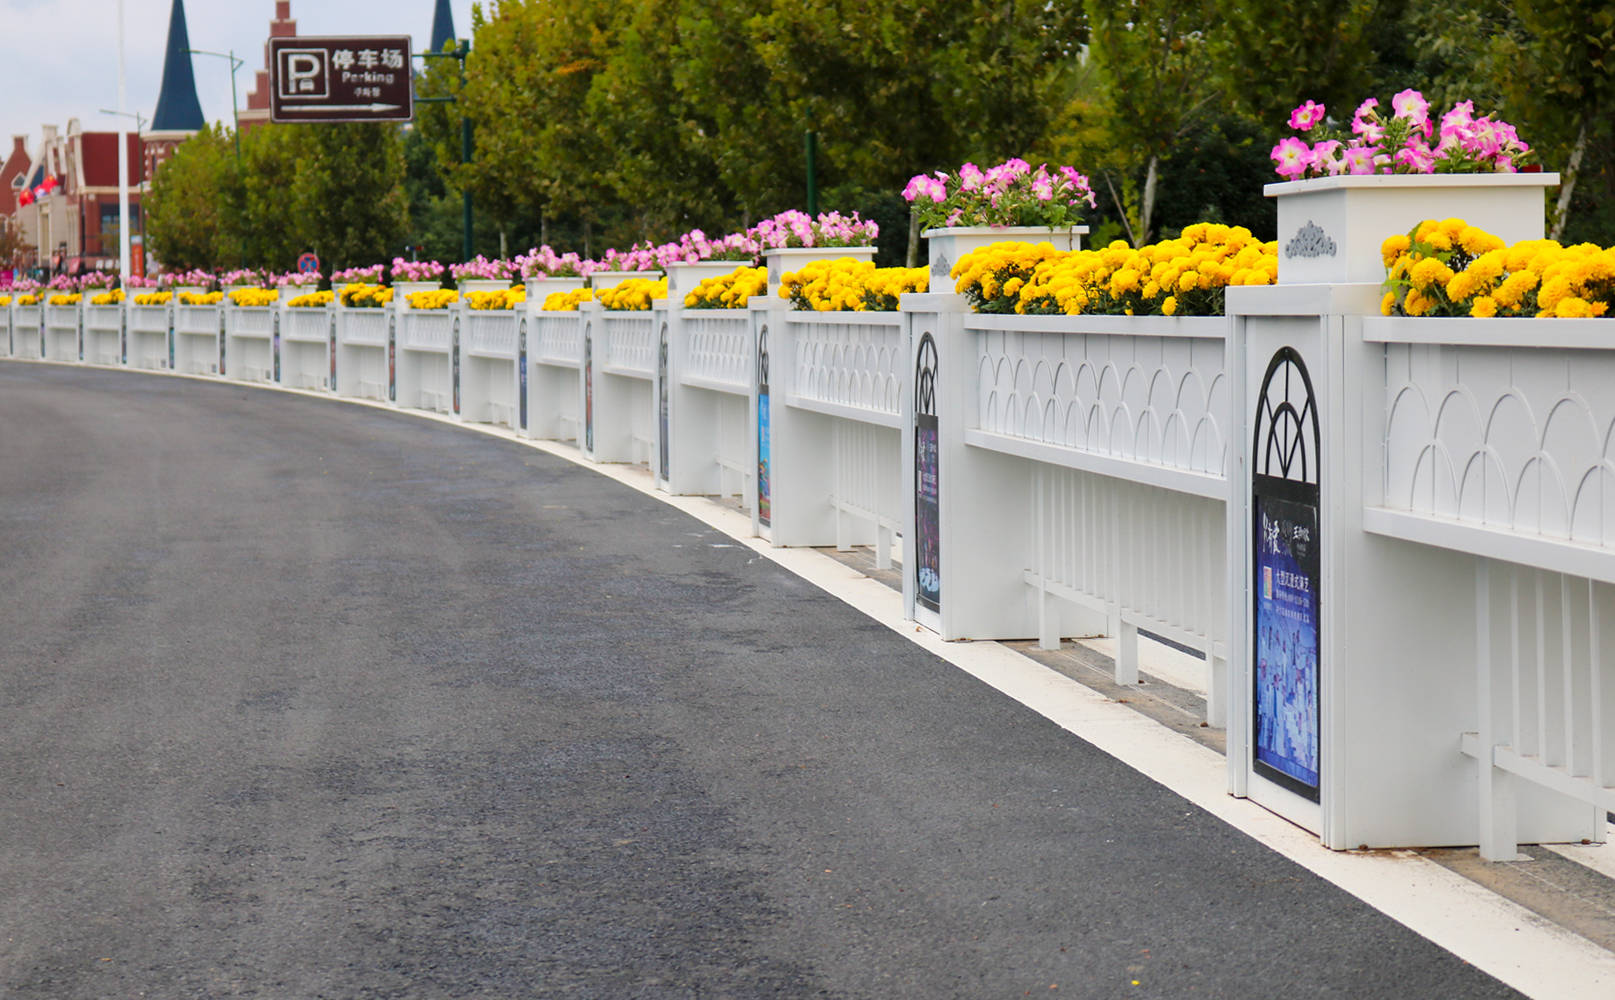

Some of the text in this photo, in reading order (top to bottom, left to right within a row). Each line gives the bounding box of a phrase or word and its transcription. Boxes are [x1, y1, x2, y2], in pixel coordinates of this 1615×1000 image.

[332, 49, 403, 69] 停车场
[341, 71, 394, 84] Parking
